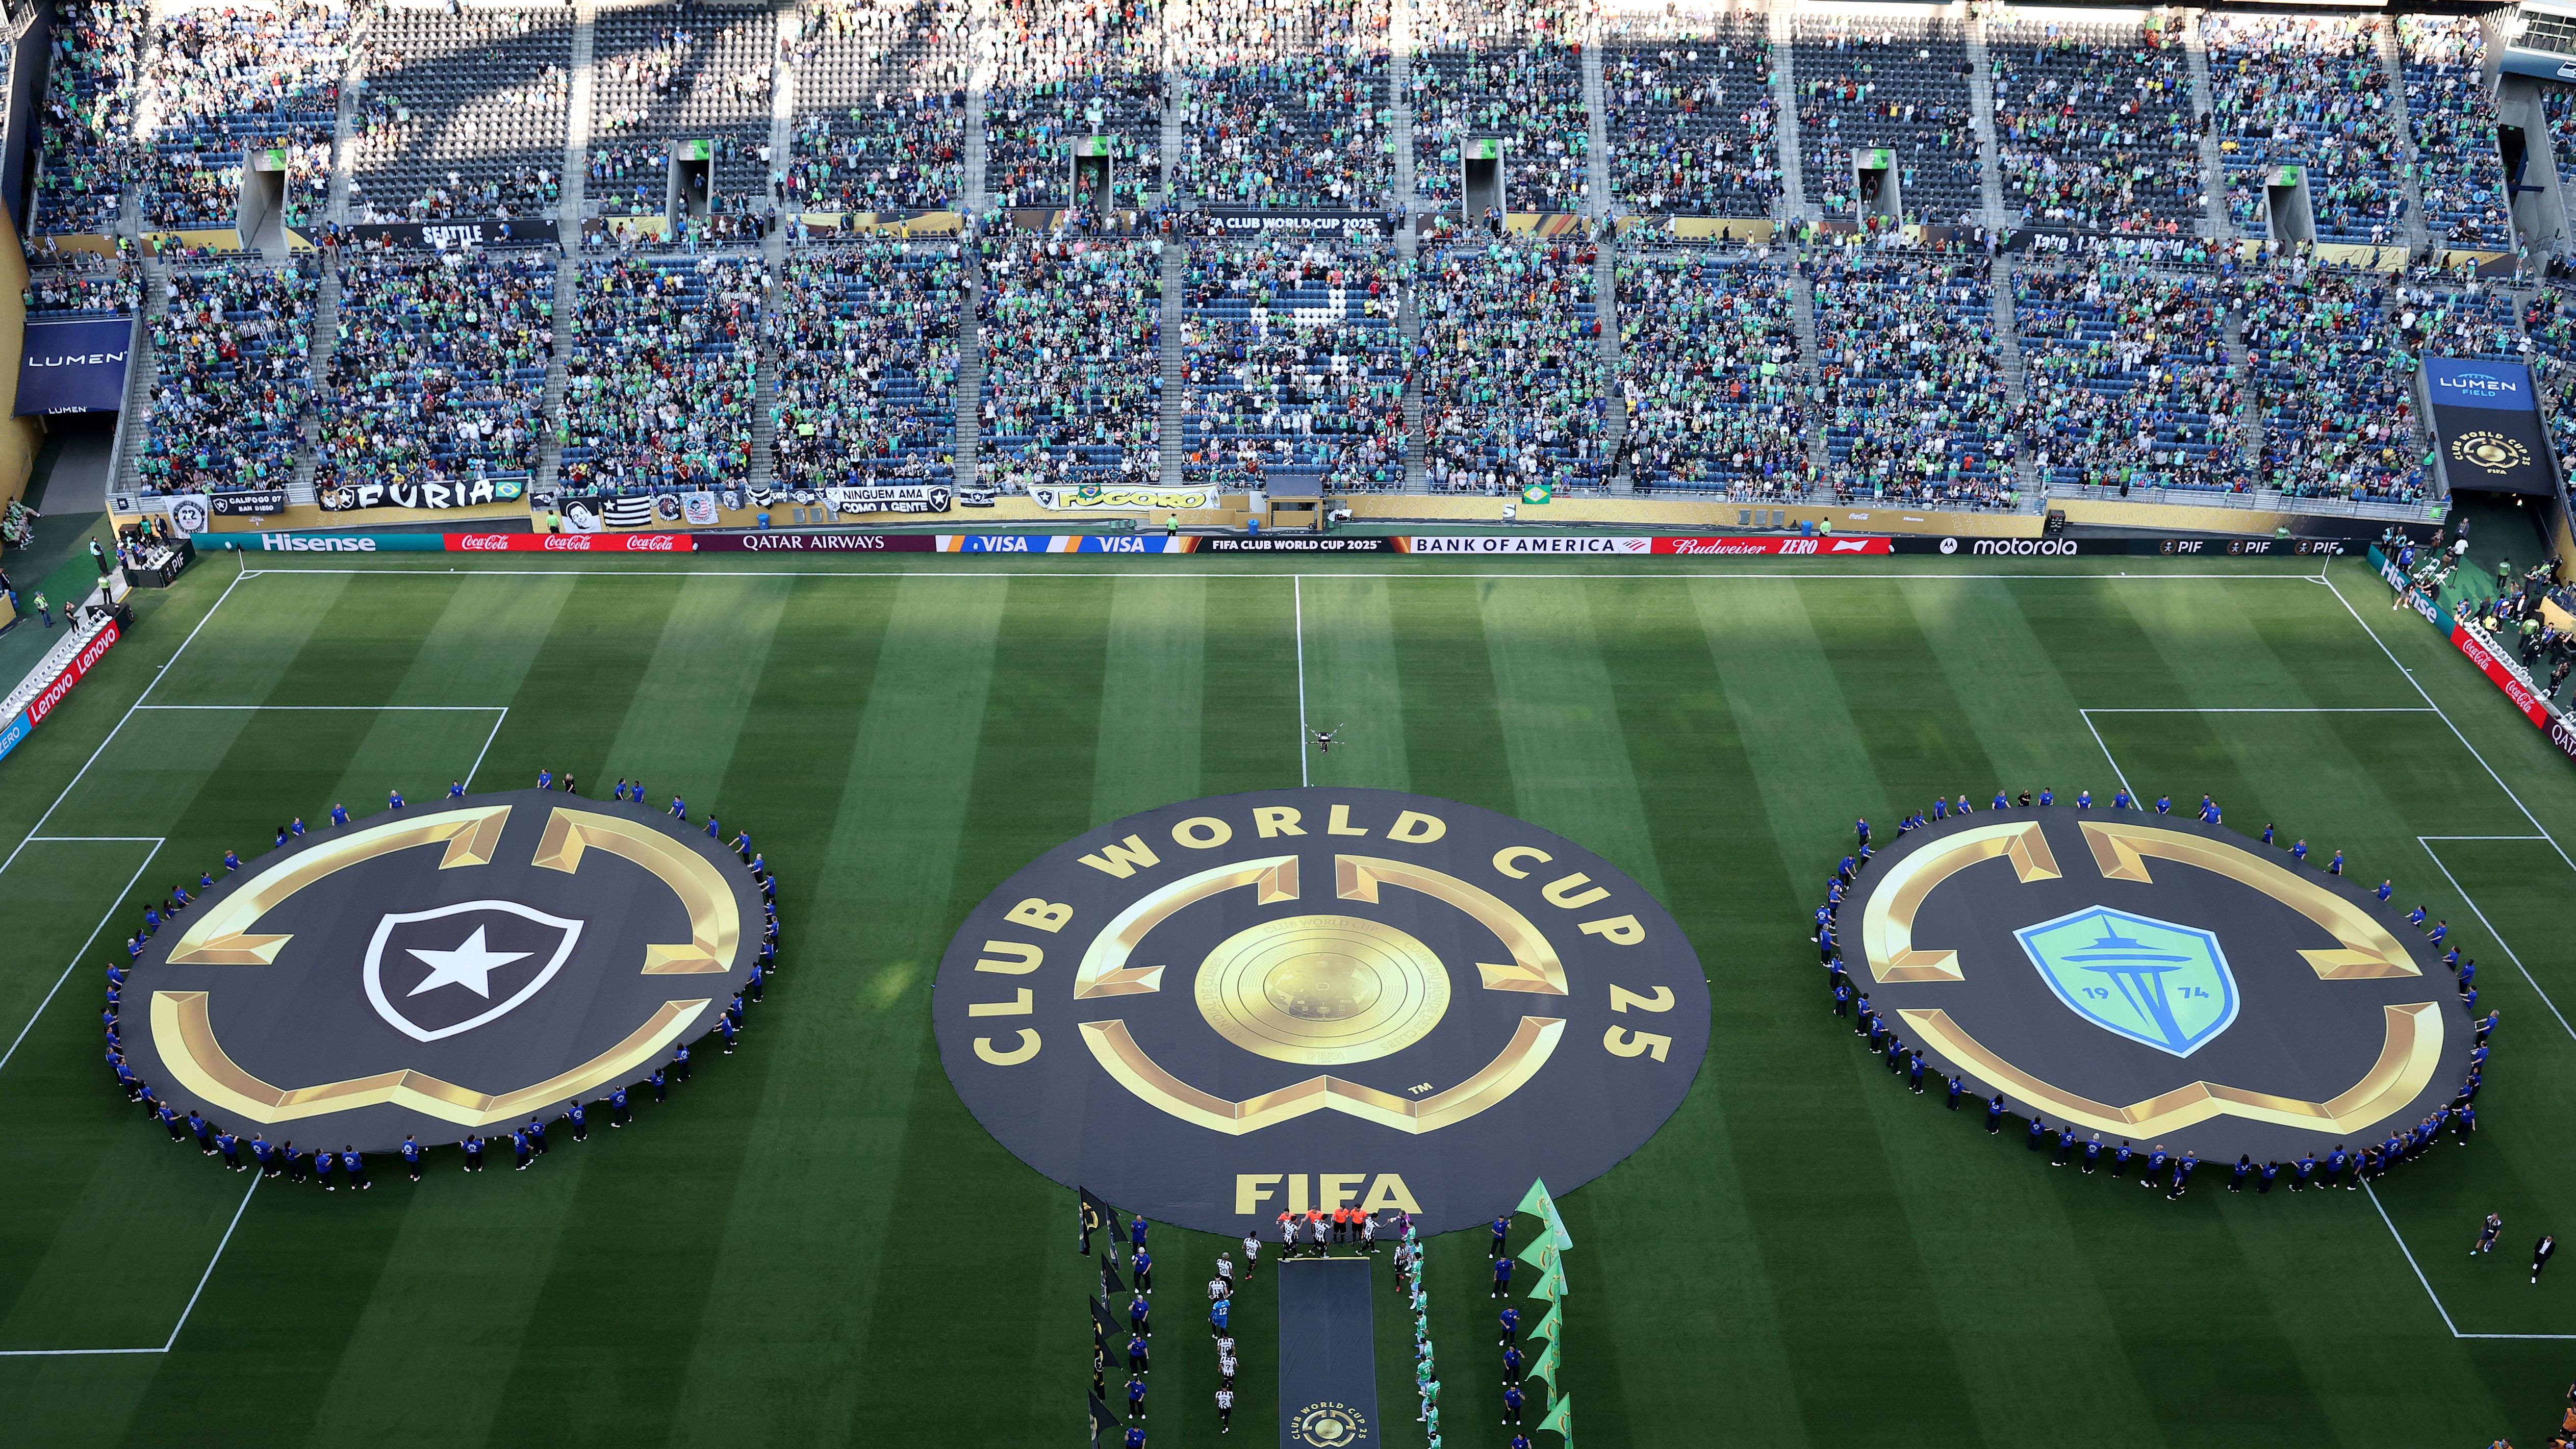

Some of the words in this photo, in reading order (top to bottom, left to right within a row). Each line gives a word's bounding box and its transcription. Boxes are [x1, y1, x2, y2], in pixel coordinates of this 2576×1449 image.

[1226, 217, 1260, 229] CLUB
[1262, 217, 1311, 230] WORLD
[1313, 218, 1340, 229] CUP
[422, 225, 483, 245] SEATTLE
[29, 351, 124, 367] LUMEN
[2439, 376, 2517, 392] LUMEN
[2462, 389, 2496, 397] FIELD
[48, 406, 86, 414] LUMEN
[2451, 440, 2464, 460] CLUB
[2459, 430, 2504, 441] WORLD
[2507, 439, 2528, 454] CUP
[229, 496, 270, 504] CALIFOGO
[843, 486, 897, 500] NINGUÉM
[899, 488, 924, 499] AMA
[182, 510, 197, 520] 22
[842, 502, 878, 513] COMO
[880, 502, 889, 512] A
[890, 501, 928, 513] GENTE
[261, 533, 376, 552] Hisense
[462, 535, 509, 551] Coca-Cola
[544, 535, 591, 551] Coca-Cola
[626, 535, 674, 551] Coca-Cola
[742, 535, 803, 551] QATAR
[810, 536, 885, 549] AIRWAYS
[979, 537, 1028, 552] VISA
[1095, 537, 1145, 553] VISA
[1212, 540, 1239, 550] FIFA
[1240, 540, 1272, 551] CLUB
[1274, 540, 1318, 550] WORLD
[1320, 540, 1345, 551] CUP
[1416, 539, 1475, 551] BANK
[1483, 539, 1510, 551] OF
[1516, 539, 1615, 552] AMERICA
[1672, 539, 1767, 554] Budweiser
[1778, 539, 1819, 554] ZERO
[1973, 540, 2078, 555] motorola
[2177, 541, 2204, 553] PIF
[2245, 541, 2271, 554] PIF
[2312, 541, 2338, 554] PIF
[171, 551, 184, 573] PIF
[2381, 558, 2438, 624] Hisnse
[76, 628, 116, 674] Lenovo
[2462, 639, 2492, 671] Coca-Cola
[30, 672, 73, 722] Lenovo
[2505, 680, 2535, 714] Coca-Cola
[1263, 919, 1297, 933] CLUB
[1299, 918, 1349, 928] WORLD
[1353, 921, 1380, 932] CUP
[968, 897, 1074, 1066] CLUB
[1077, 804, 1447, 880] WORLD
[1492, 846, 1646, 947] CUP
[1603, 983, 1677, 1064] 25
[1404, 942, 1436, 967] COUPE
[2082, 987, 2109, 999] 19
[2177, 987, 2210, 999] 74
[1205, 1001, 1245, 1039] MUNDIAL
[1307, 1051, 1345, 1061] FIFA
[1235, 1173, 1423, 1215] FIFA
[1219, 1307, 1228, 1315] 12
[1291, 1415, 1302, 1440] CLUB
[1300, 1402, 1344, 1414] WORLD
[1348, 1408, 1366, 1424] CUP
[1358, 1428, 1368, 1439] 25
